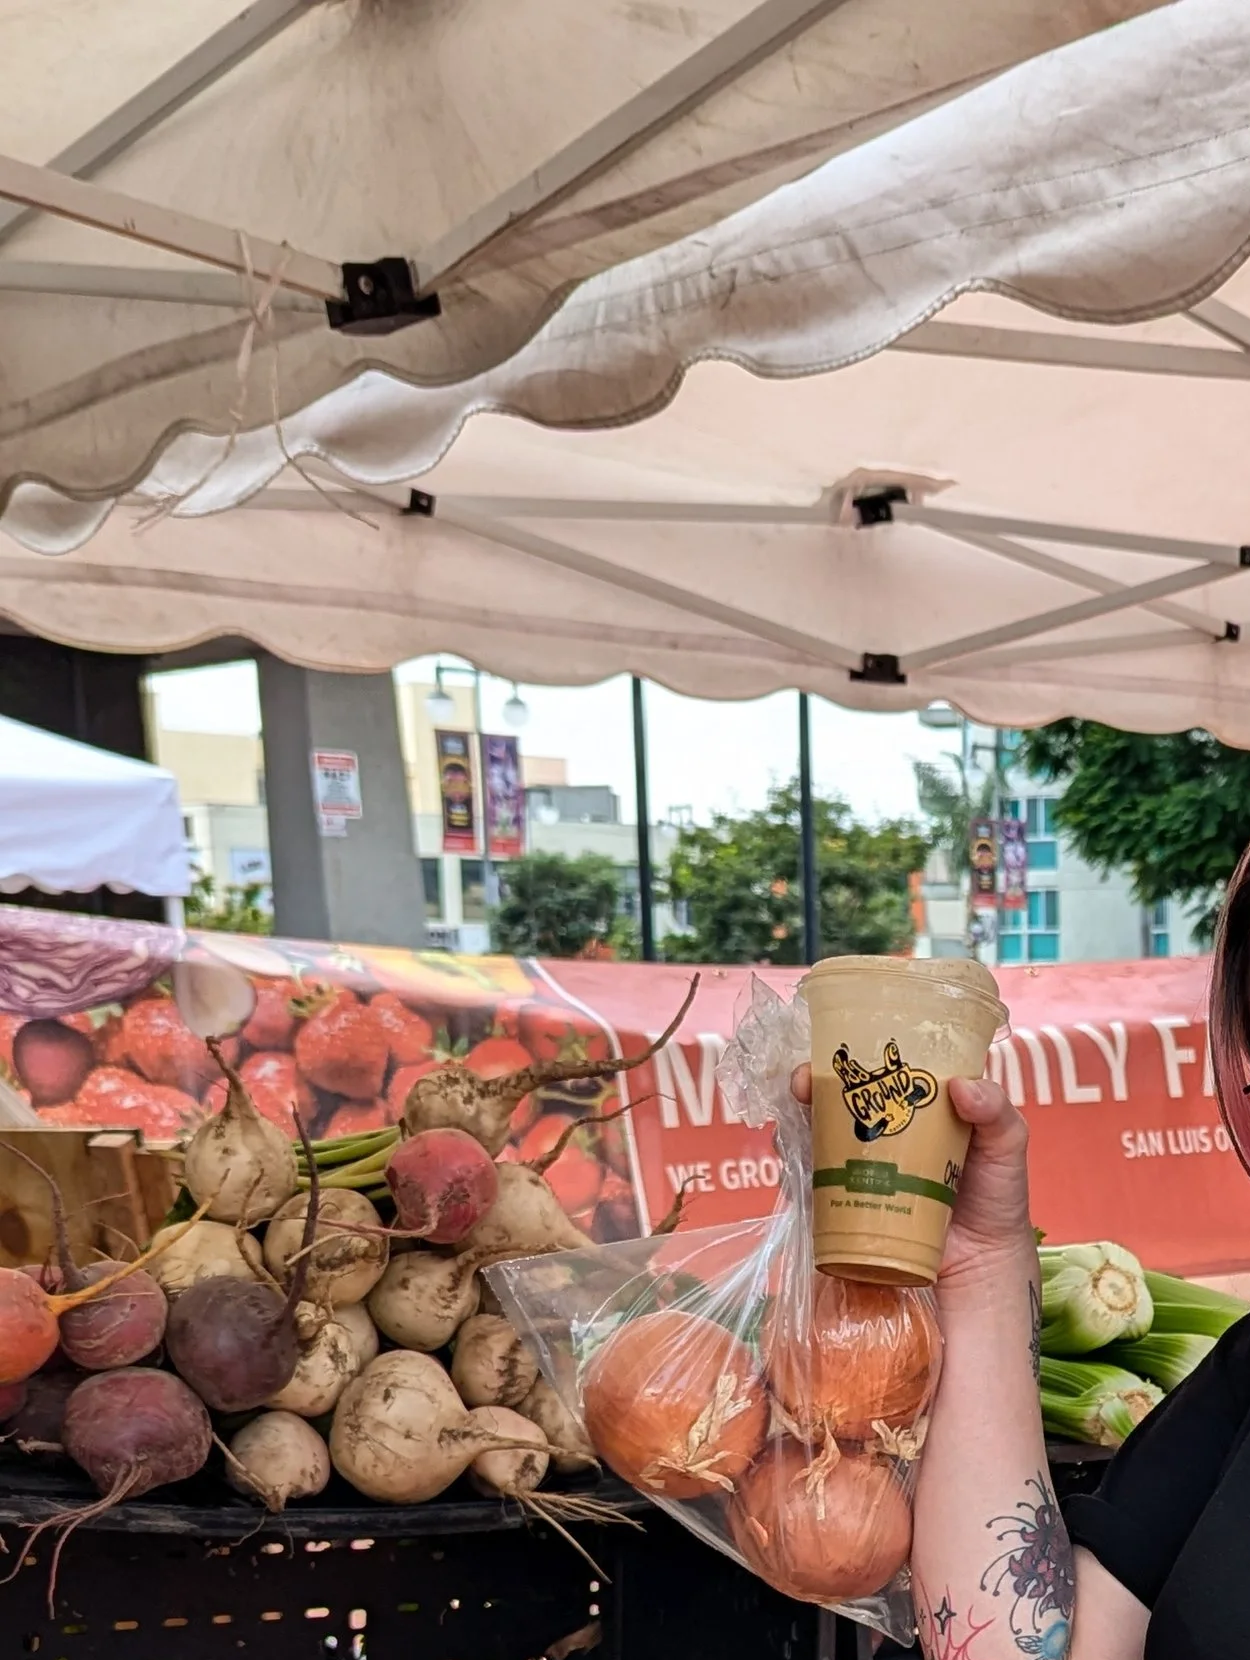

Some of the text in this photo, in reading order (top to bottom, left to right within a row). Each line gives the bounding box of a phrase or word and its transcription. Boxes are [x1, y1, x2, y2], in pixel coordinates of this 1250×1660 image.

[983, 1019, 1129, 1107] MILY
[852, 1070, 910, 1121] GROUND
[1121, 1129, 1164, 1159] SAN
[1167, 1125, 1212, 1156] LUIS
[665, 1156, 785, 1194] WE GRO
[853, 1200, 882, 1209] Better
[884, 1203, 912, 1215] World
